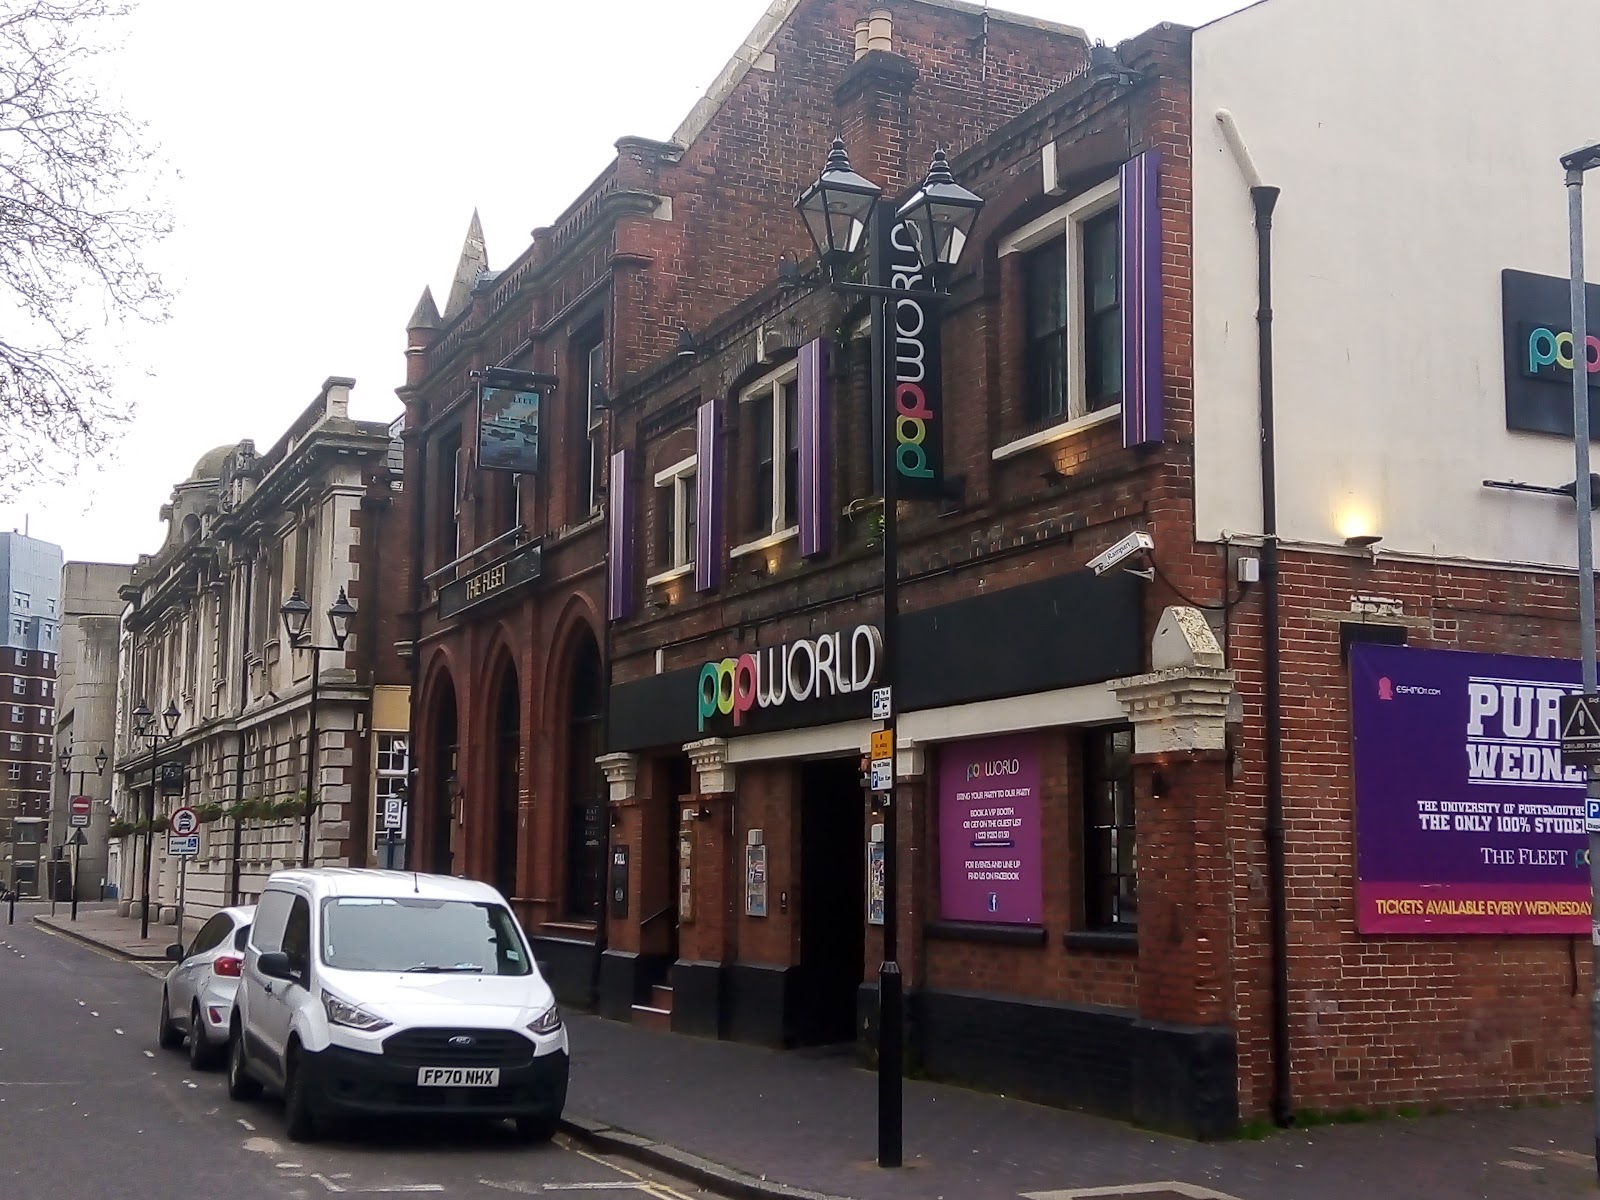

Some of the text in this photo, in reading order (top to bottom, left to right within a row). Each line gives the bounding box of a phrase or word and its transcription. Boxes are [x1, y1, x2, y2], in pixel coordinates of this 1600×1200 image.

[1107, 541, 1131, 560] Rampart
[465, 574, 482, 600] THE
[1467, 682, 1584, 740] PUR
[1466, 743, 1588, 782] WEDN
[971, 791, 984, 800] YOUR
[1005, 789, 1015, 797] OUR
[970, 808, 983, 817] BOOK
[988, 808, 997, 816] VIP
[997, 807, 1014, 816] BOOTH
[1417, 800, 1438, 812] THE
[1440, 801, 1501, 814] UNIVERSITY
[1503, 803, 1516, 815] OF
[1590, 803, 1599, 817] P
[1419, 813, 1450, 831] THE
[1454, 815, 1492, 832] ONLY
[1497, 816, 1531, 833] 100%
[1481, 847, 1568, 866] THE FLEET
[1376, 899, 1593, 916] TICKETS AVAILABLE EVERY WEDNESDAY
[423, 1069, 494, 1085] FP70 NHX
